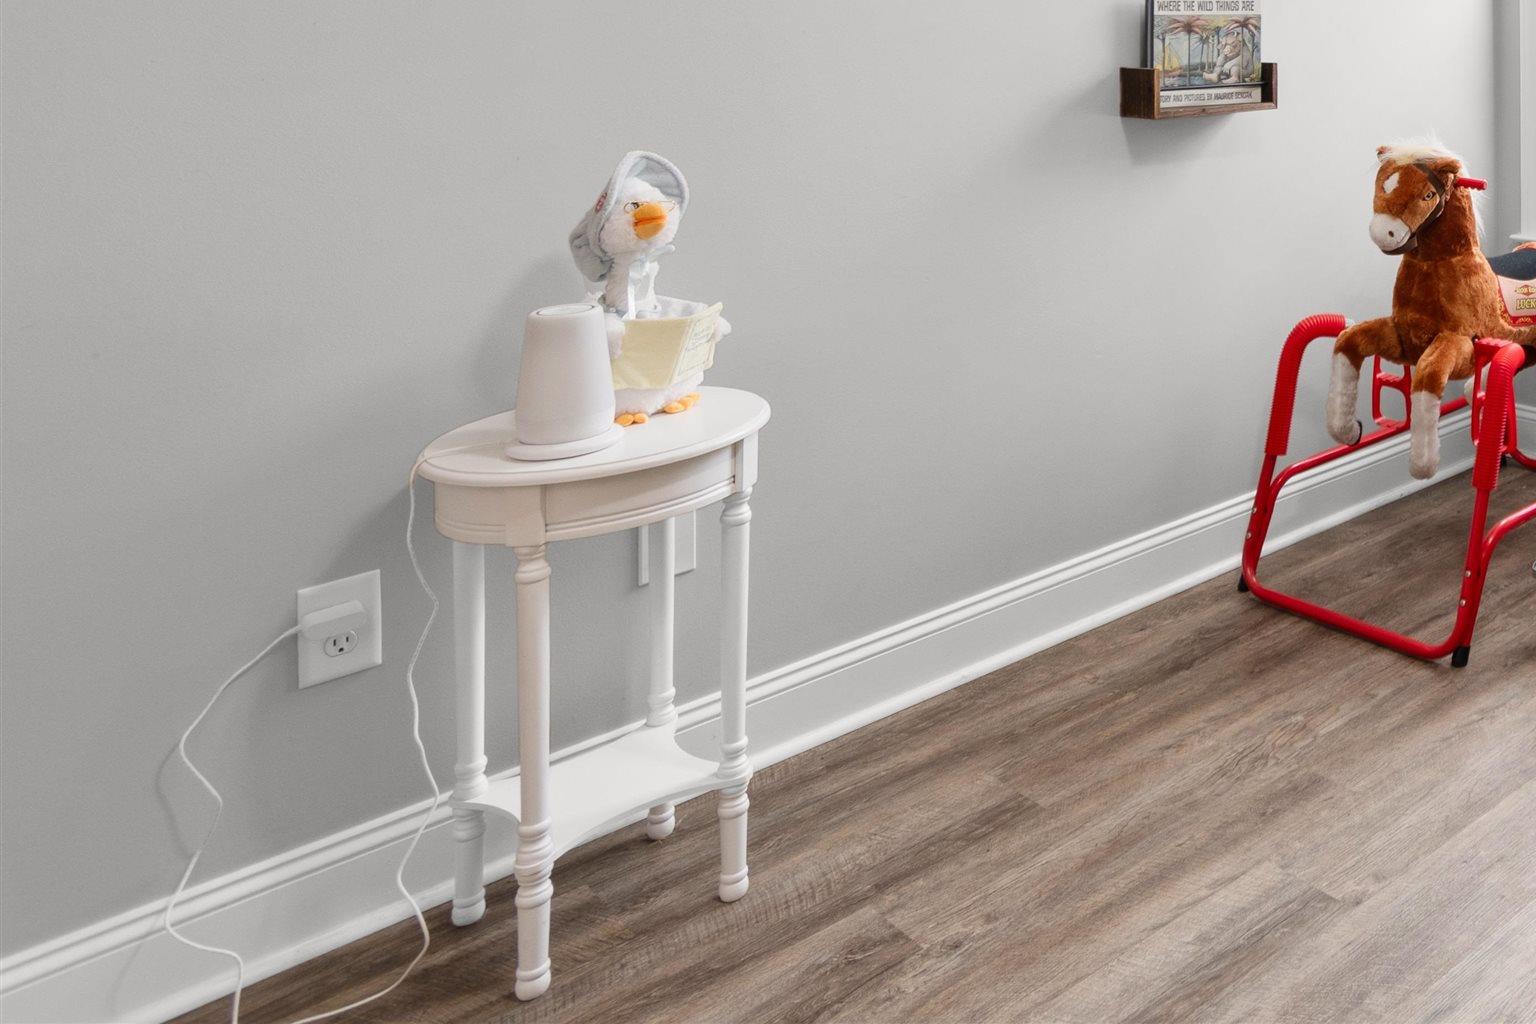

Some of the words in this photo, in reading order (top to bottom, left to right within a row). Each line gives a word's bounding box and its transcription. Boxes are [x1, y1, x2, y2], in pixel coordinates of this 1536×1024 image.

[1156, 0, 1181, 12] WHERE
[1183, 0, 1195, 12] THE
[1197, 0, 1213, 12] WILD
[1215, 0, 1240, 12] THINGS
[1241, 0, 1255, 12] ARE
